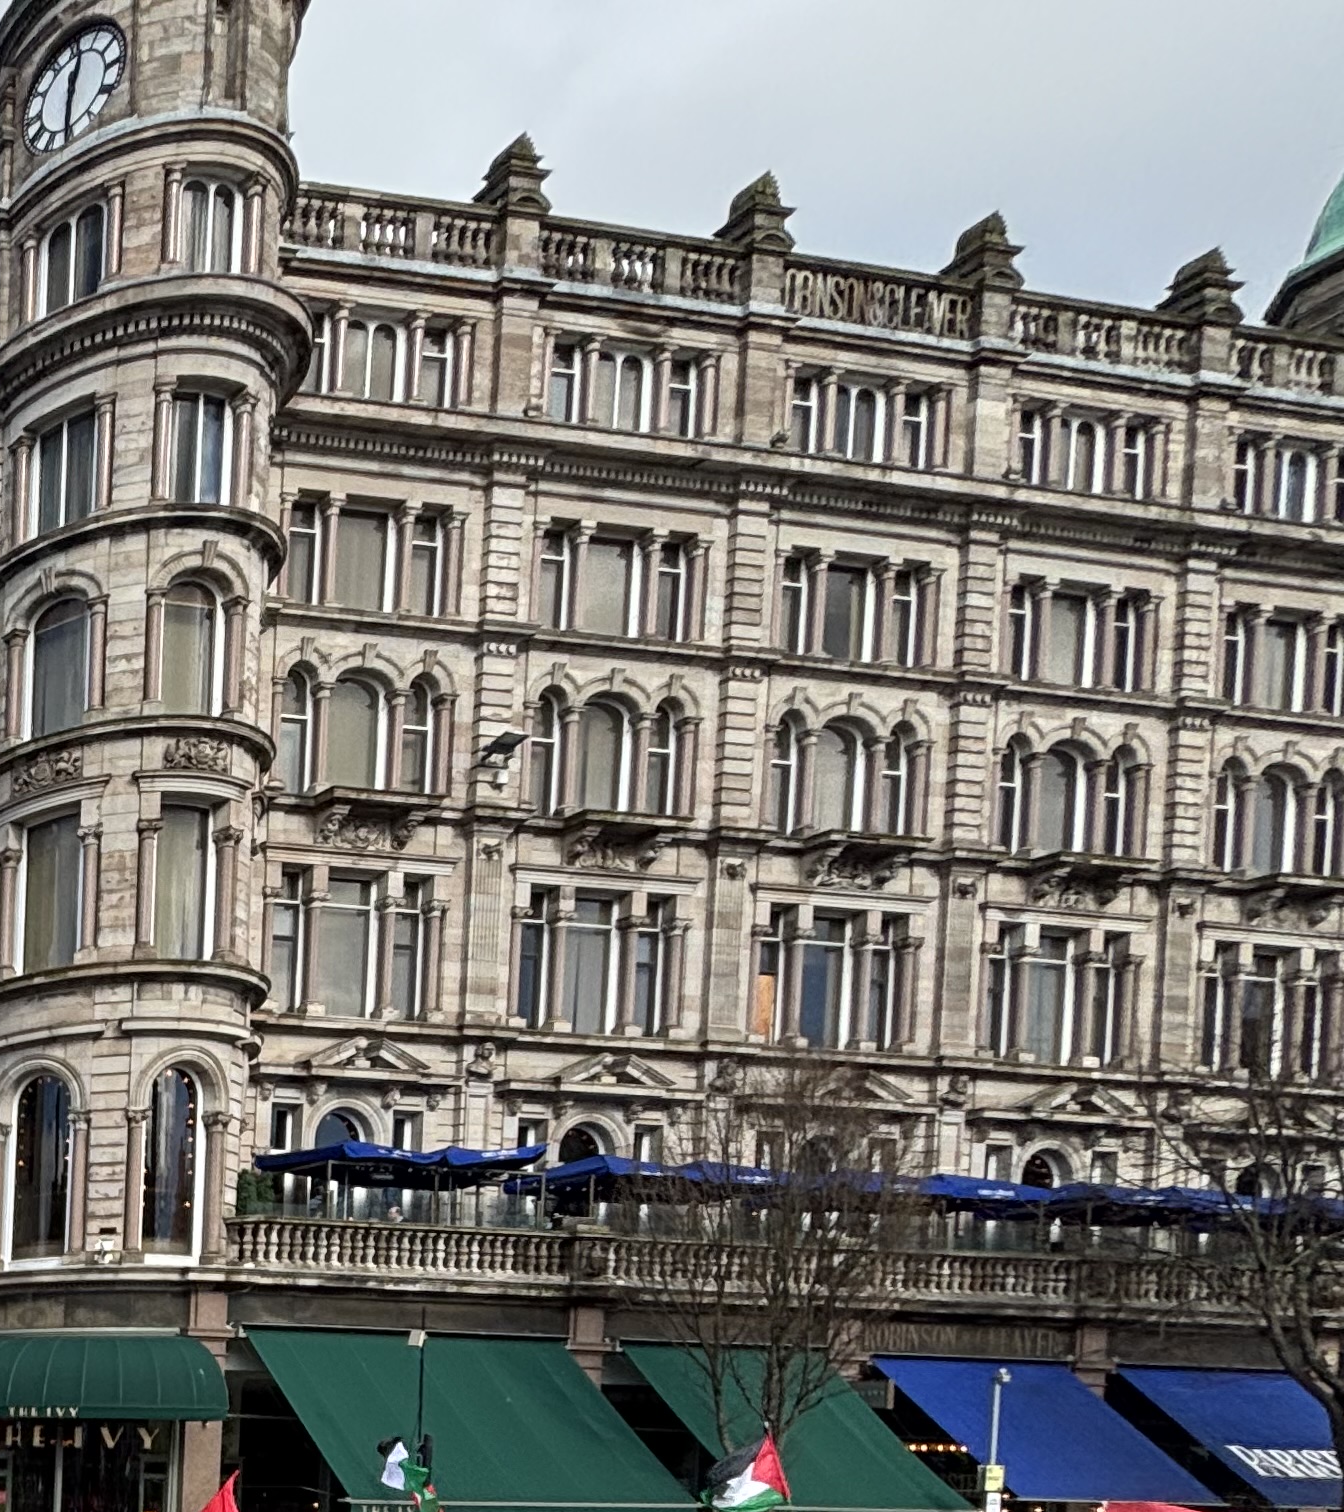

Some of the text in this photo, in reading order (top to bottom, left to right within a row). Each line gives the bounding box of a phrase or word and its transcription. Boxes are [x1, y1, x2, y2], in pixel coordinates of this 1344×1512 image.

[9, 1407, 79, 1418] THE IVY
[73, 1425, 160, 1449] IVY
